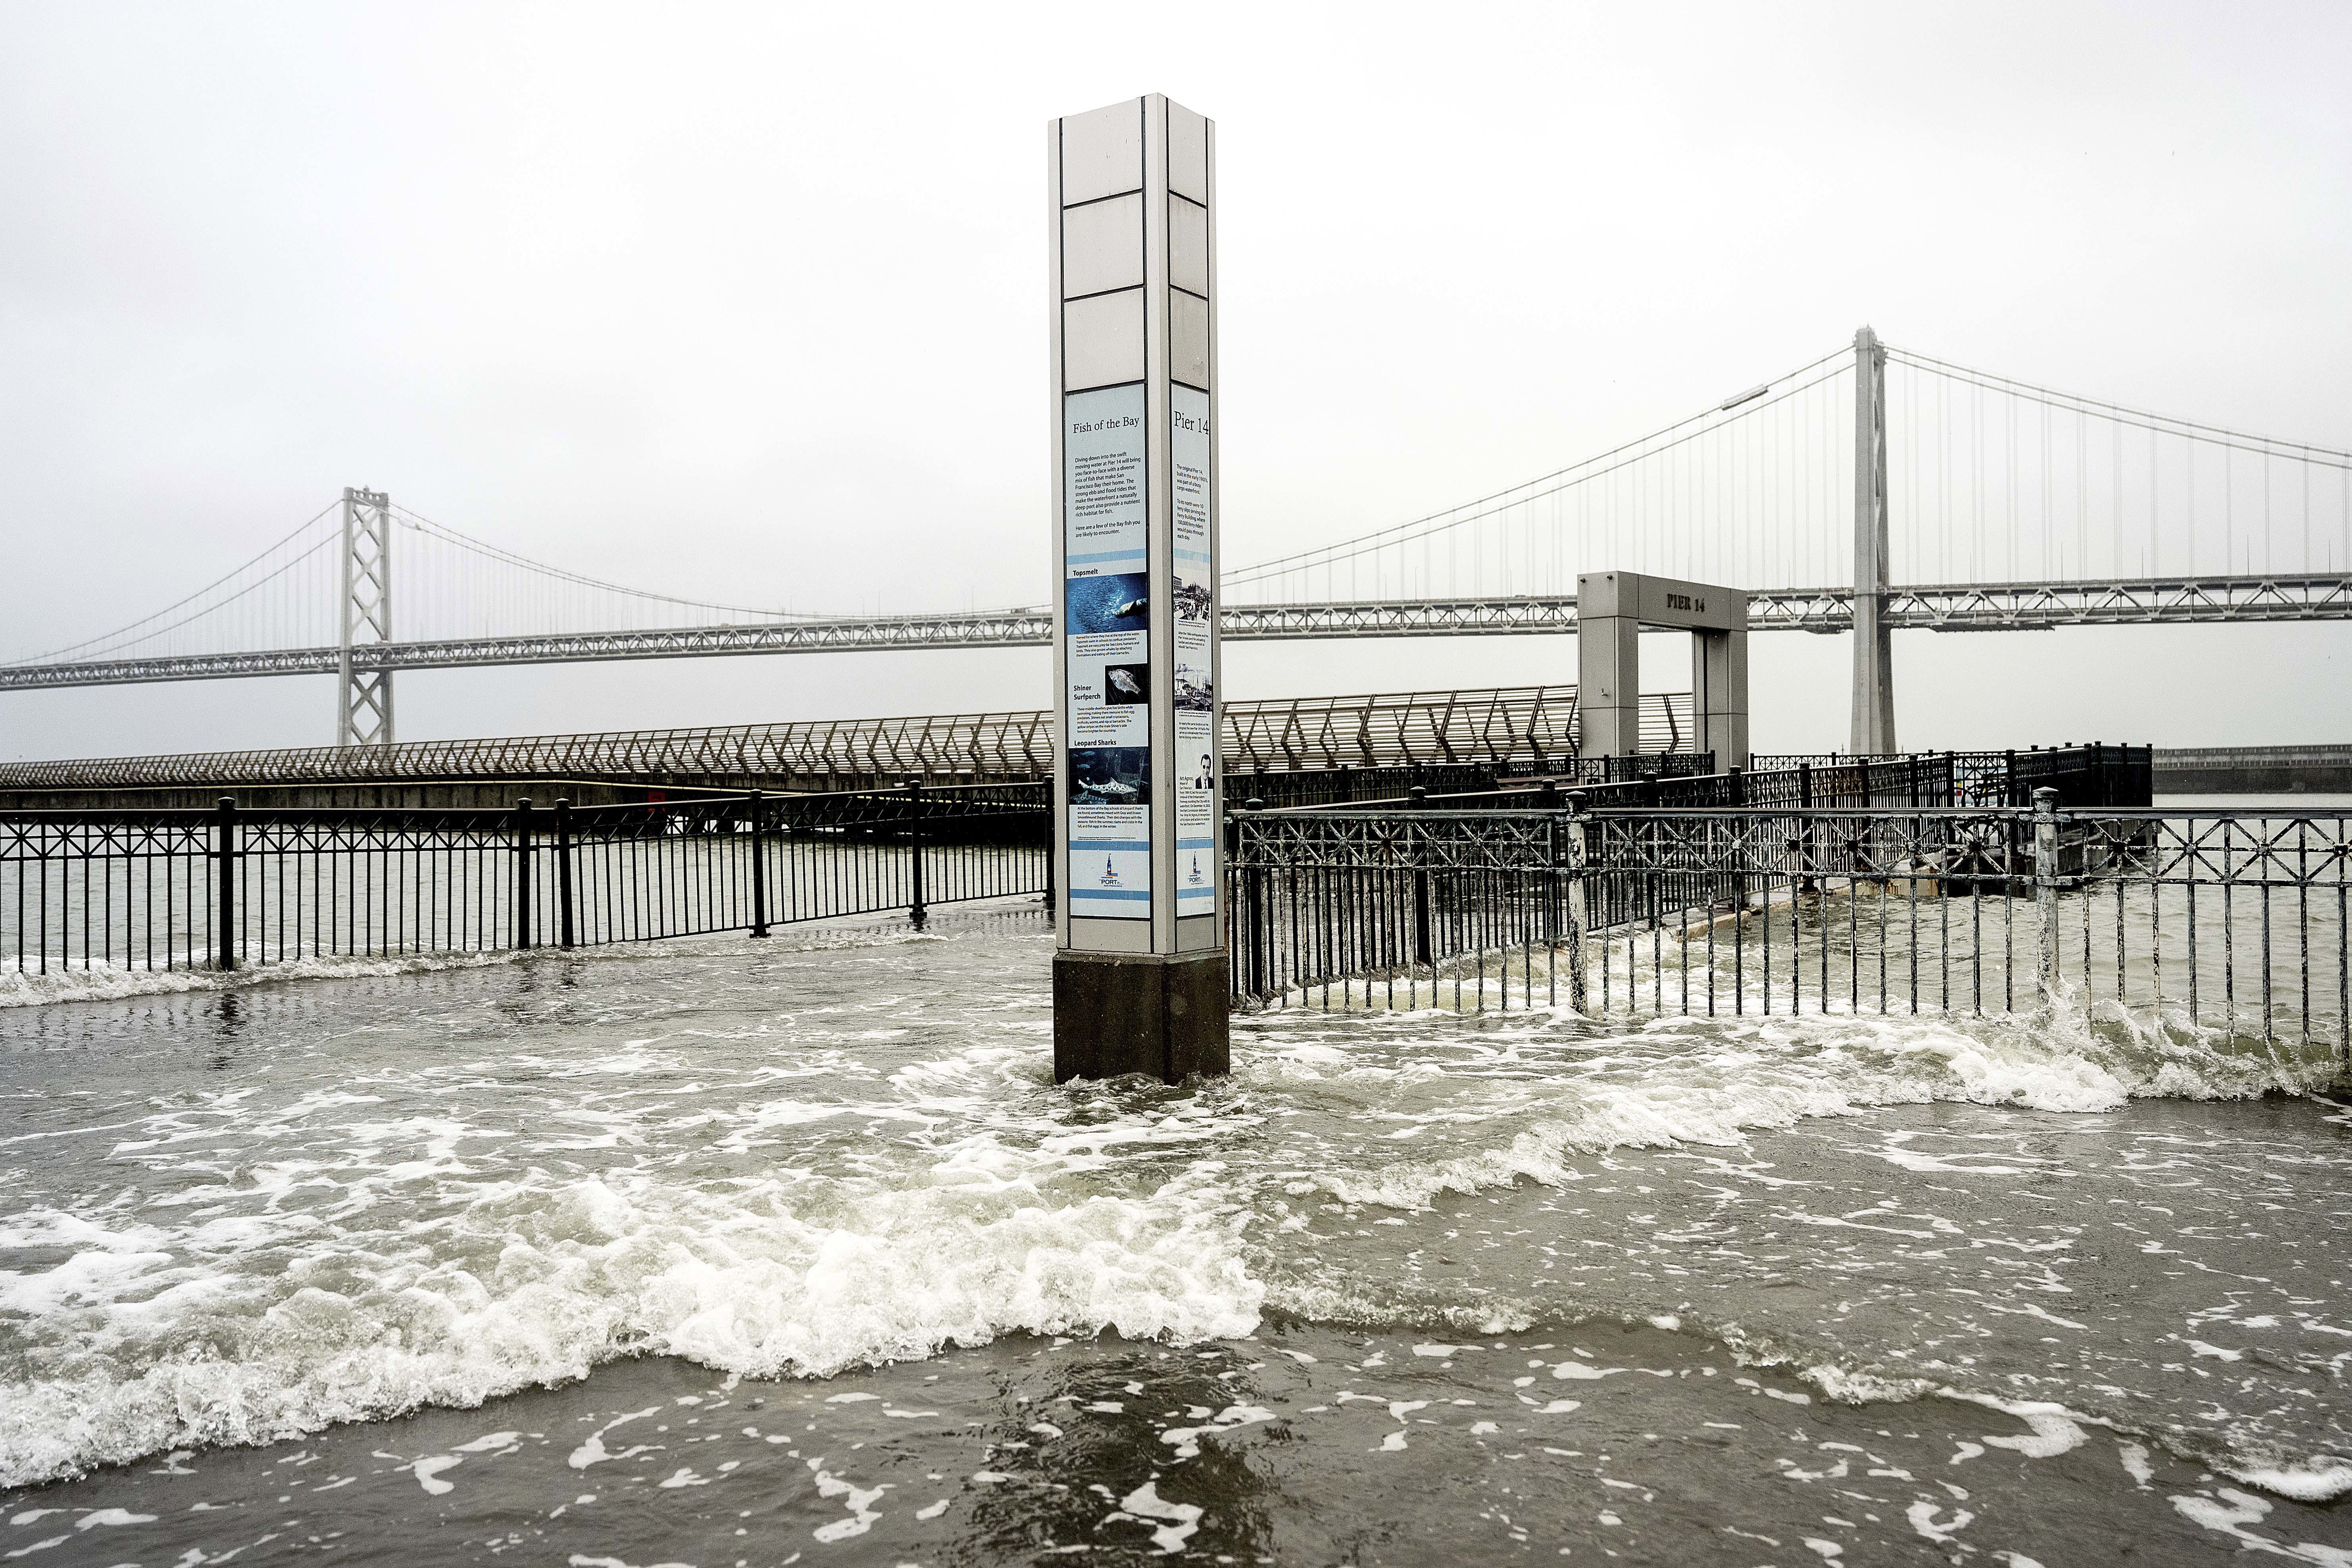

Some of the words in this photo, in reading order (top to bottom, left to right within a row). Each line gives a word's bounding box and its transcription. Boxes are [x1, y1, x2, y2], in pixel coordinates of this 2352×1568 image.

[1073, 422, 1092, 433] Fish
[1094, 420, 1104, 431] of
[1106, 419, 1120, 429] the
[1123, 417, 1140, 428] Bay
[1174, 410, 1194, 431] Pier
[1198, 417, 1209, 435] 14
[1073, 568, 1098, 577] Topsmelt
[1667, 594, 1691, 610] PIER
[1695, 598, 1705, 612] 14
